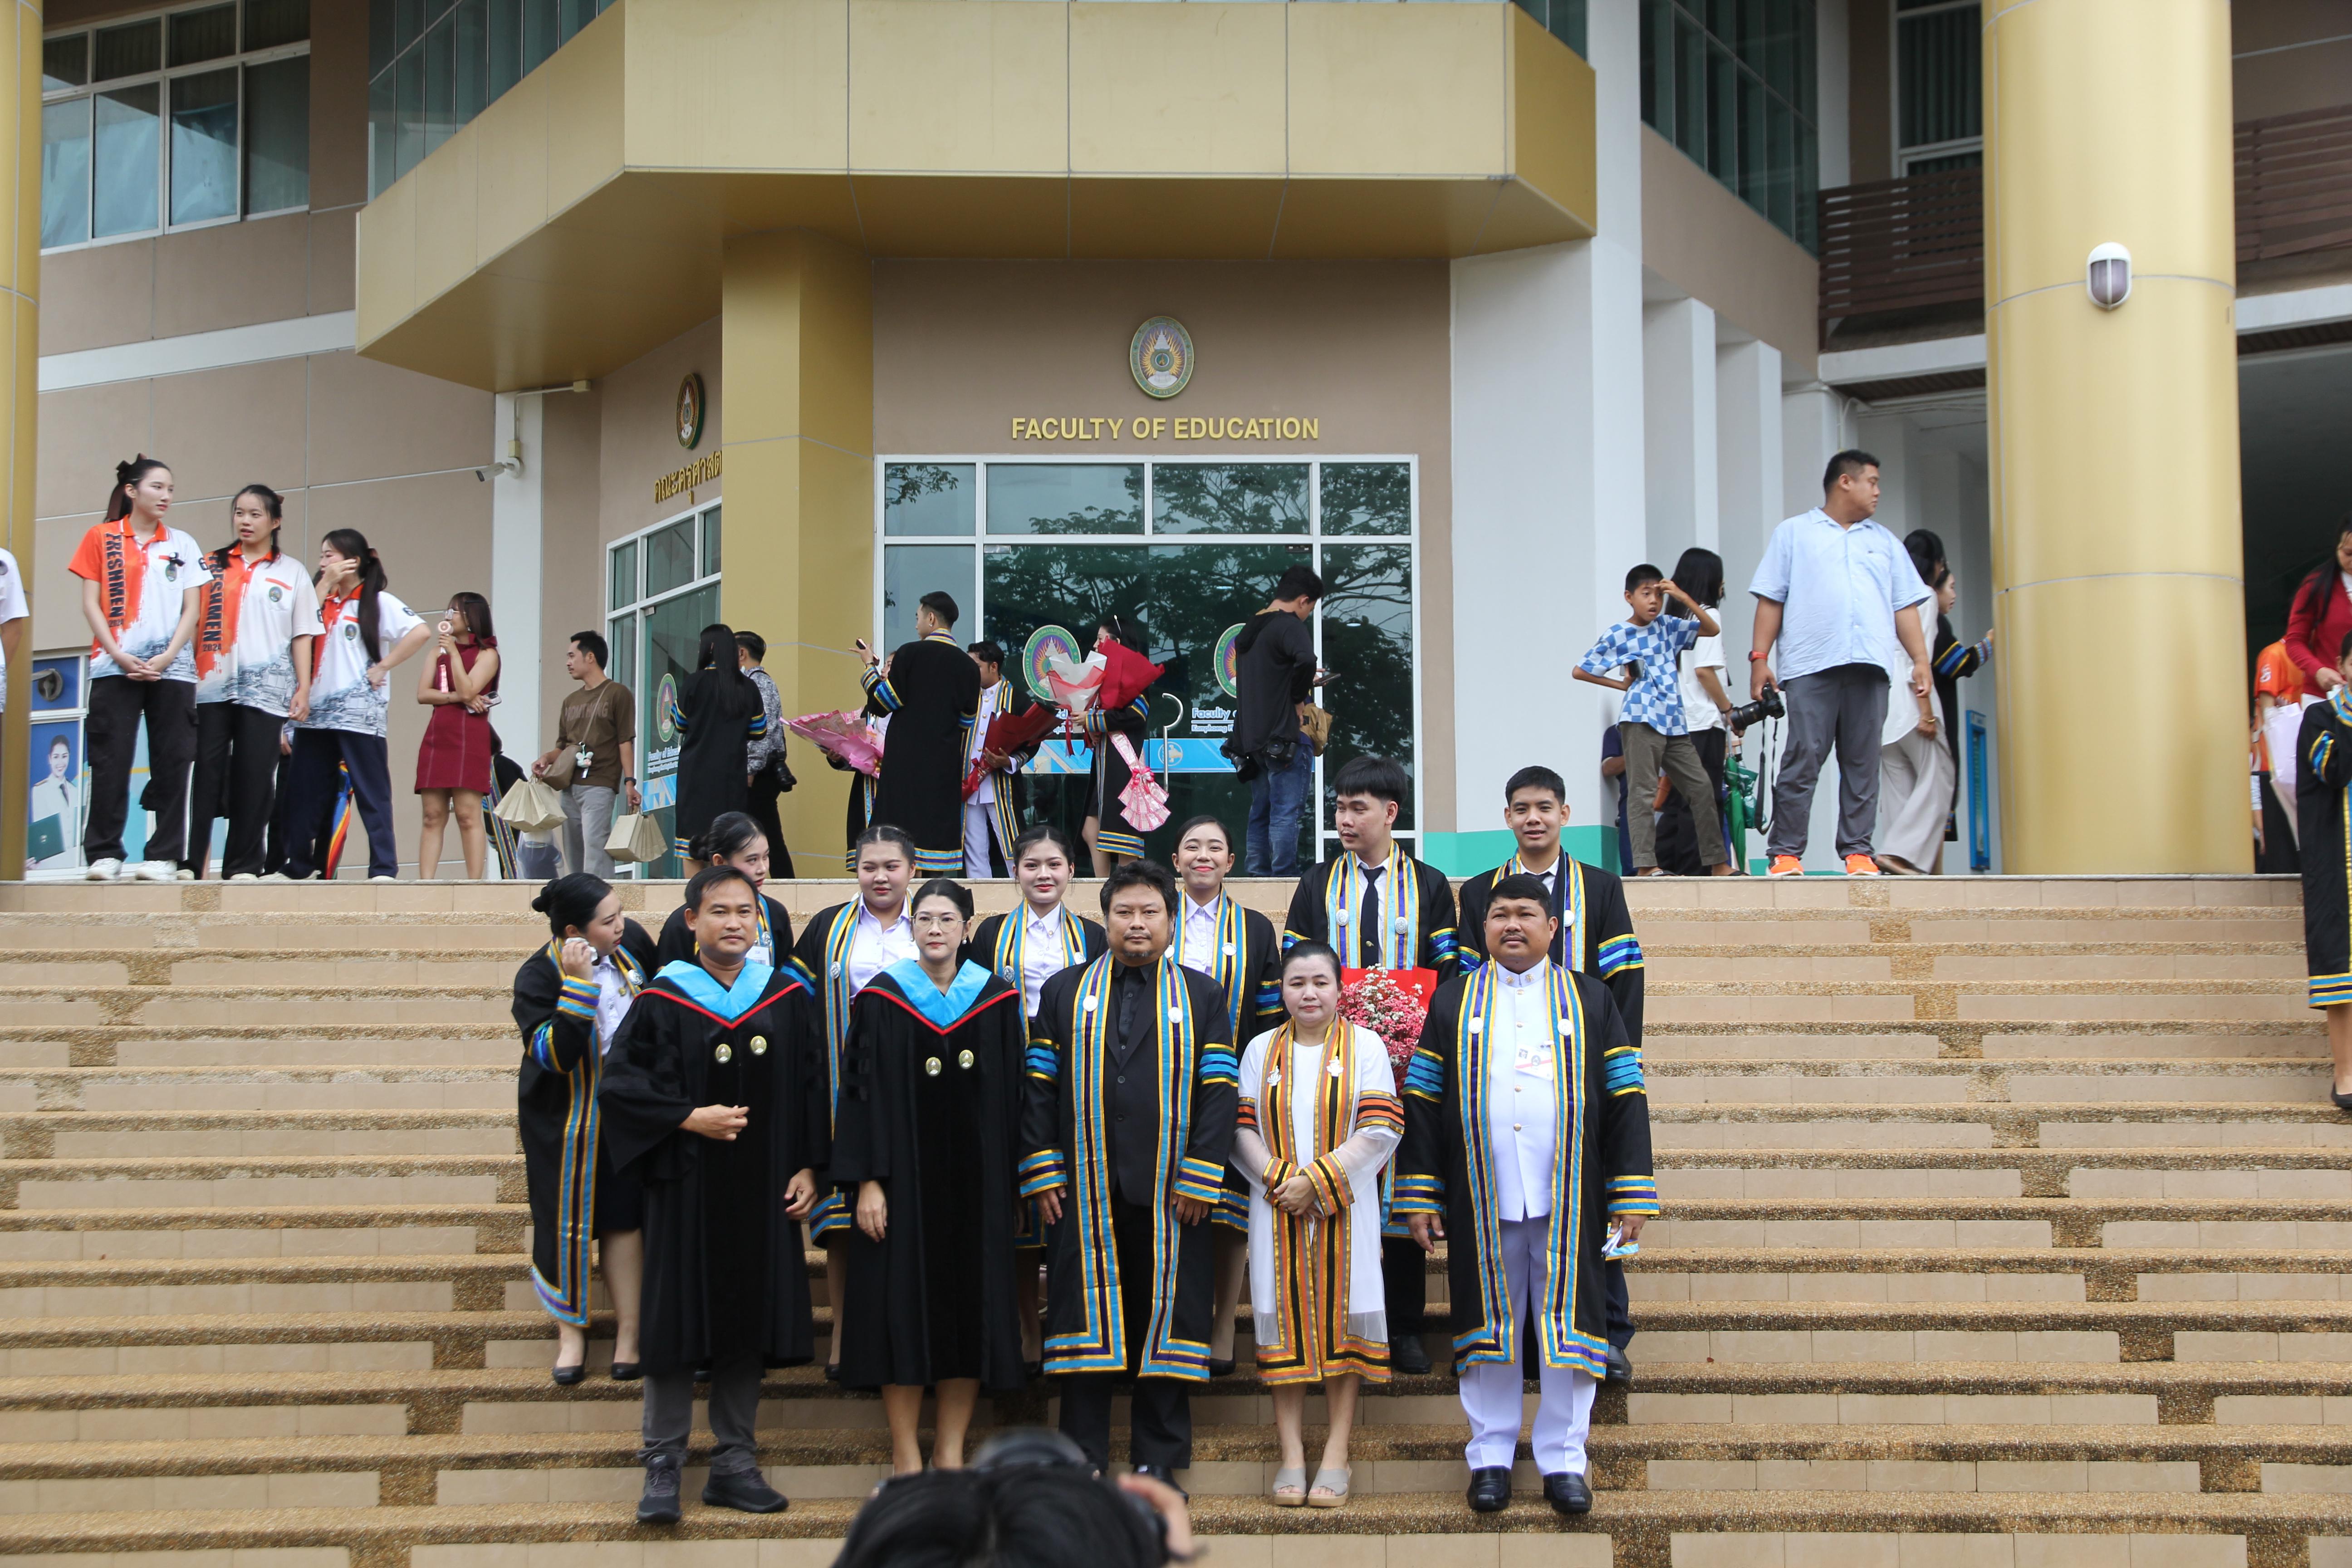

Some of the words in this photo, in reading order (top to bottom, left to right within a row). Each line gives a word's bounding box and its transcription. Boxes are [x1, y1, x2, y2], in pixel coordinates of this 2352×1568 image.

[1012, 417, 1124, 439] FACULTY
[1132, 416, 1166, 439] OF
[1174, 416, 1318, 439] EDUCATION
[655, 451, 722, 505] คณะครุศาสต
[105, 532, 125, 618] FRESHMEN
[203, 643, 221, 652] 2024
[1192, 706, 1231, 720] Faculty
[1191, 724, 1228, 734] Kamphaeng
